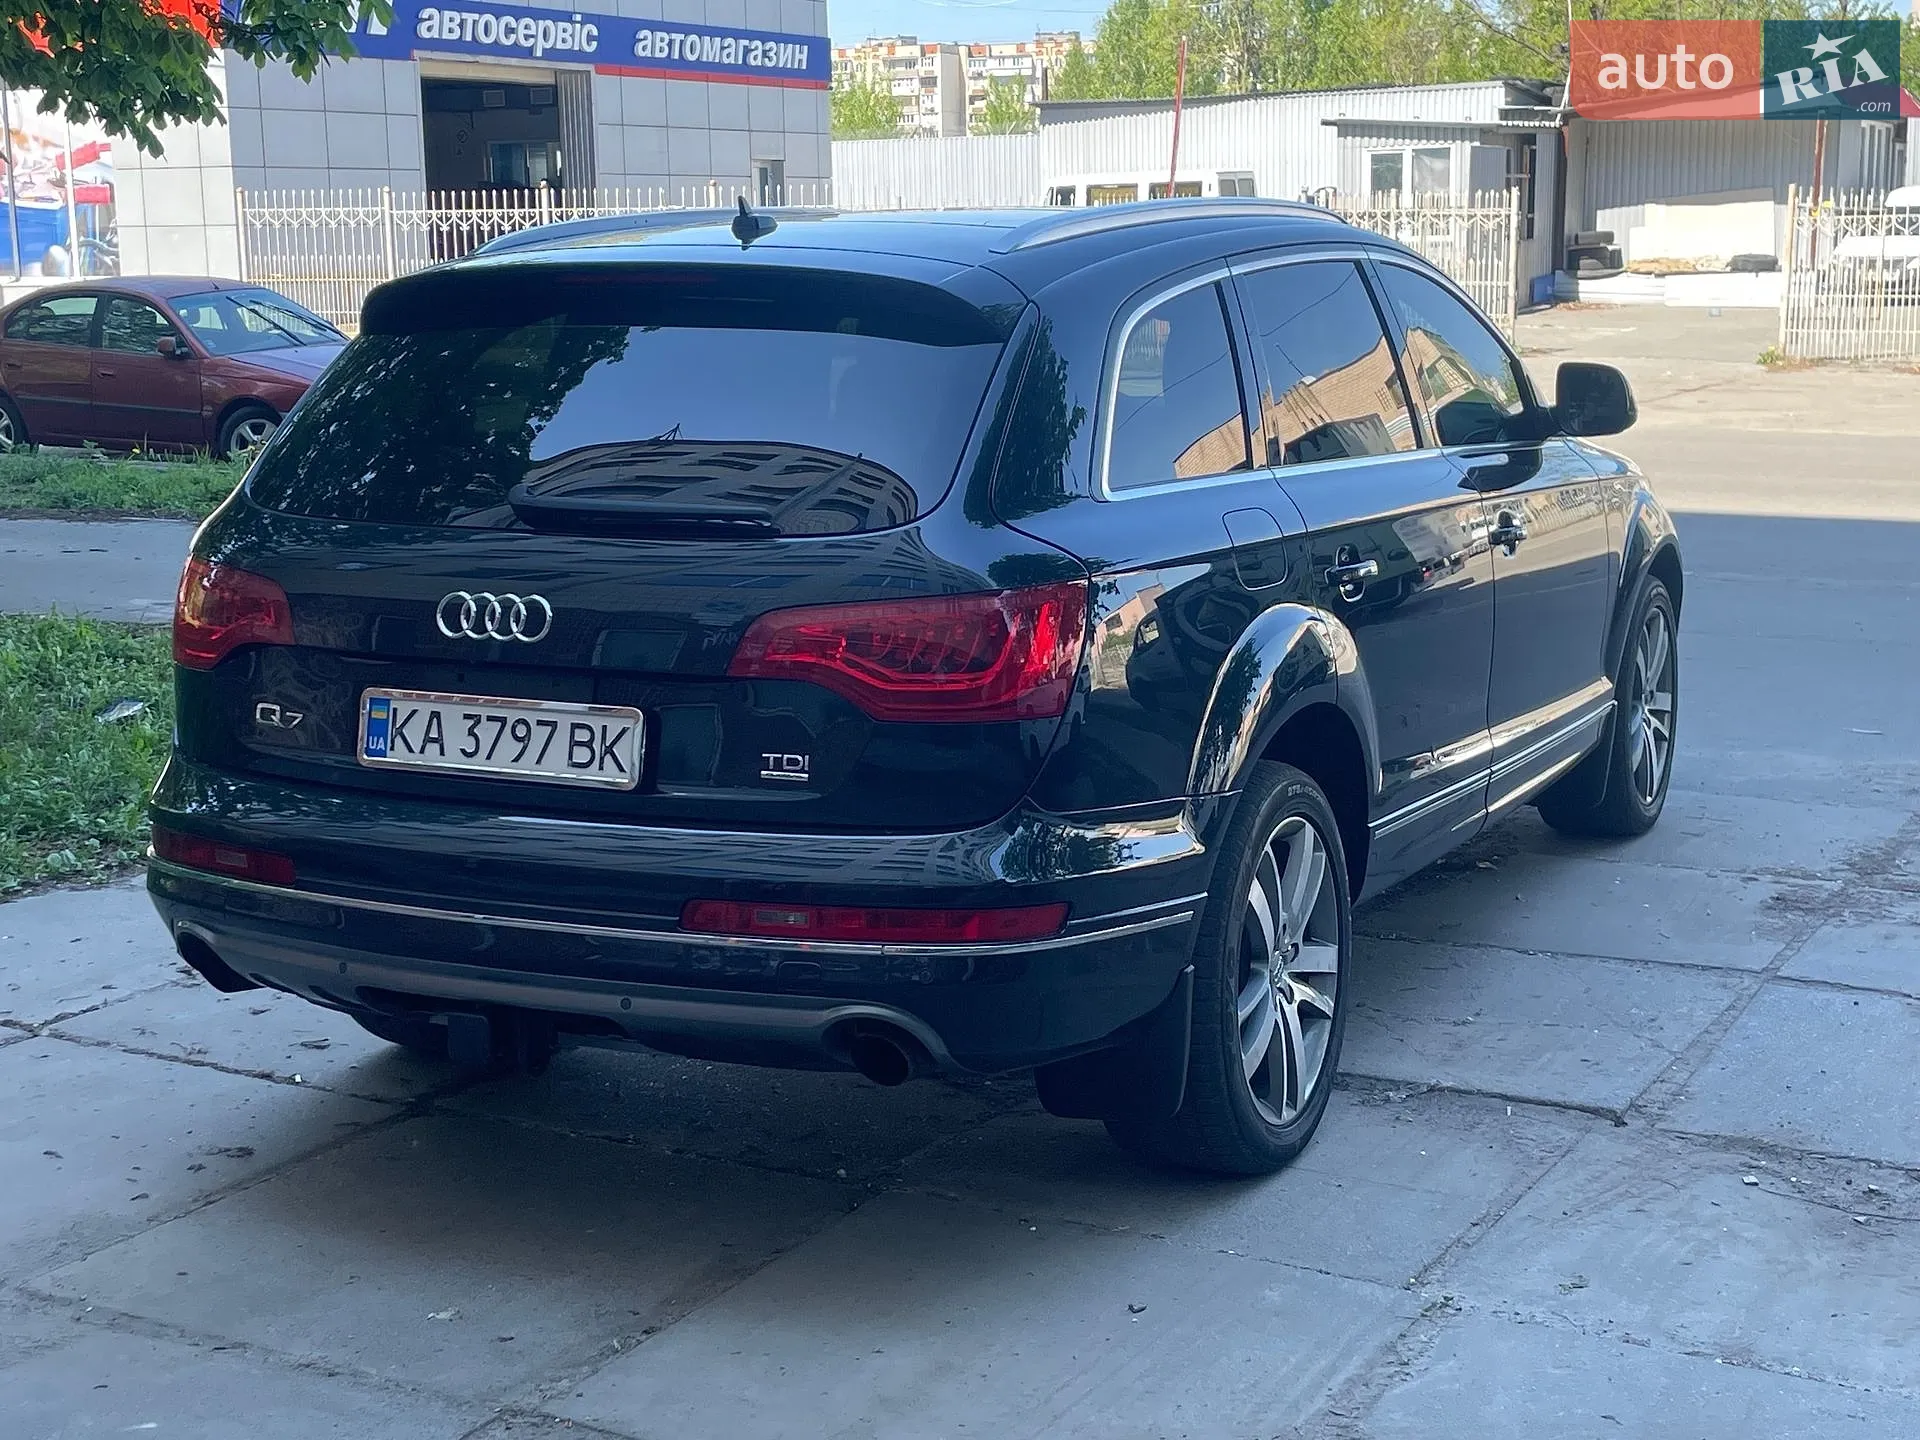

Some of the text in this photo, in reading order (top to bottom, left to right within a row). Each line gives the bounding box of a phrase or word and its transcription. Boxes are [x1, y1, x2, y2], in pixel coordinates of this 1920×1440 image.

[416, 7, 599, 57] автосервіс
[634, 29, 809, 70] автомагазин
[256, 702, 304, 729] Q7
[368, 735, 386, 751] UA
[390, 707, 631, 774] KA 3797 BK
[761, 753, 810, 771] TDI
